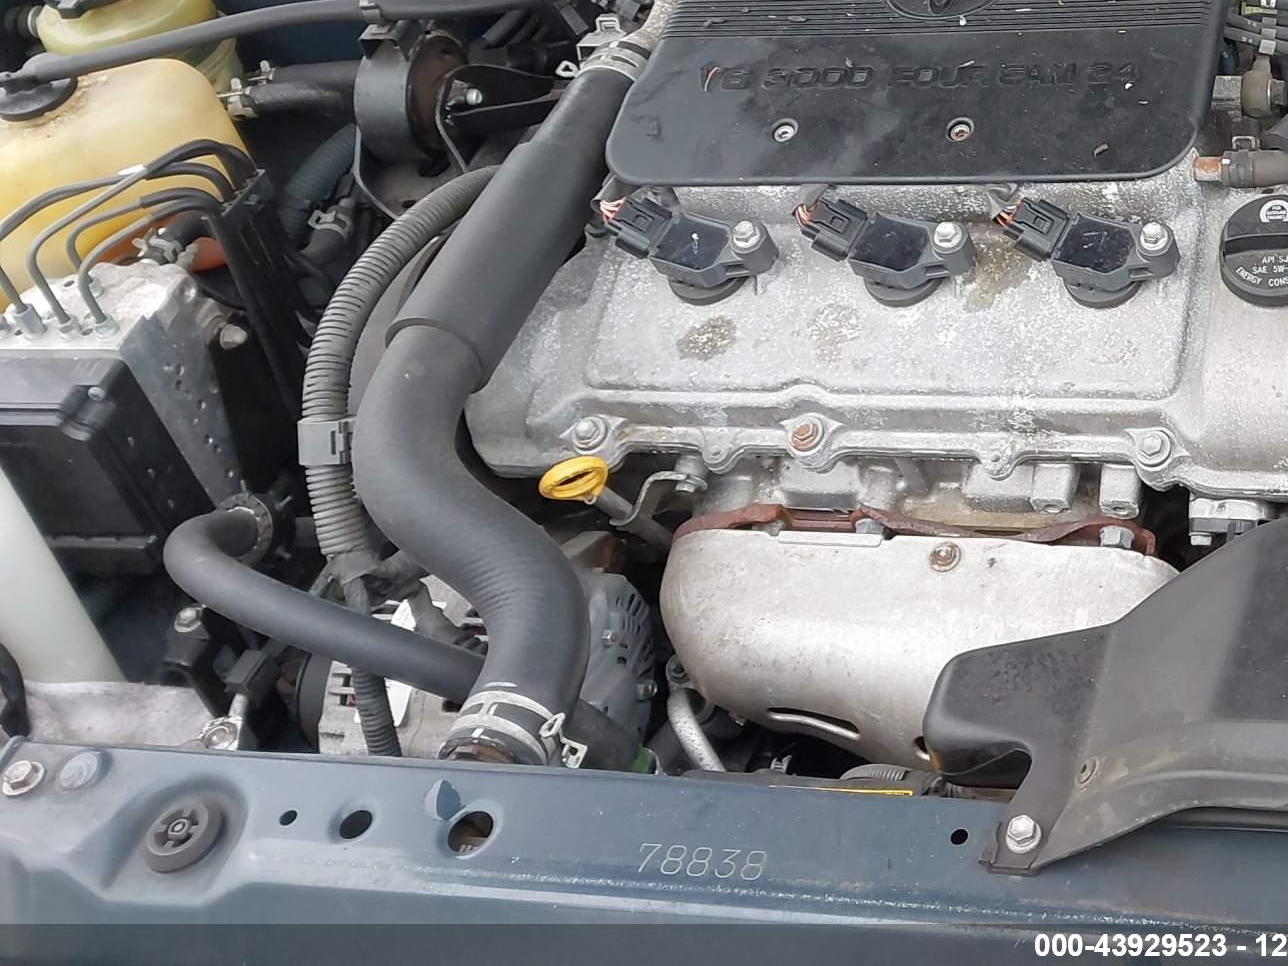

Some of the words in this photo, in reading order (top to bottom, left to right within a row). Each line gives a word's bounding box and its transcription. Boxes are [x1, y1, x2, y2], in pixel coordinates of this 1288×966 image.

[763, 66, 877, 90] 3000
[888, 65, 993, 89] FOUR
[1262, 256, 1274, 264] API
[1278, 255, 1288, 263] SJ
[1235, 267, 1263, 285] ENERGY
[1252, 267, 1268, 275] SAE
[638, 843, 768, 881] 78838
